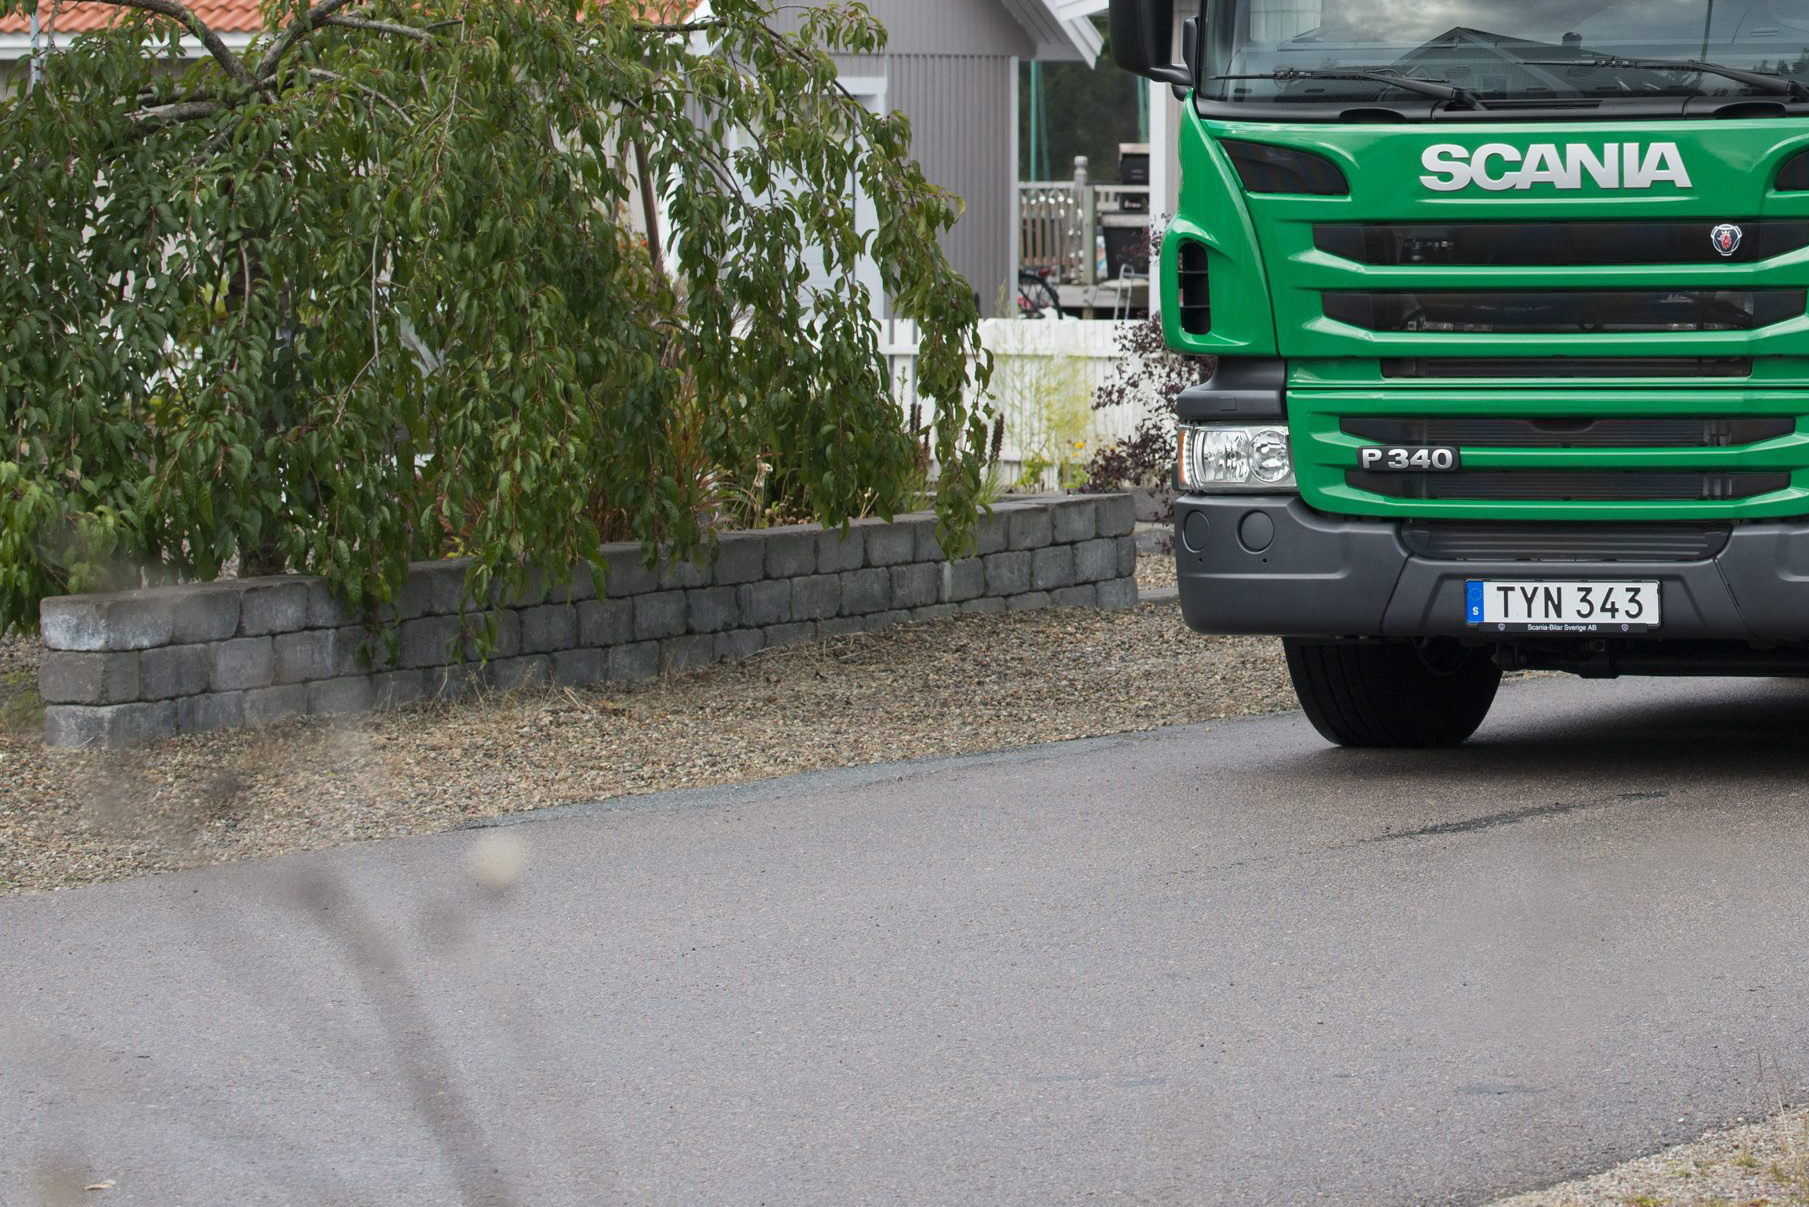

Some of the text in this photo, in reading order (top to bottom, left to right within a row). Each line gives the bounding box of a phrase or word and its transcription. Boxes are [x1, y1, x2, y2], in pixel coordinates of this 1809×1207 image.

[1419, 142, 1693, 191] SCANIA
[1362, 448, 1453, 469] P 340
[1496, 586, 1643, 619] TYN 343
[1527, 623, 1562, 631] Scania-Bilar
[1563, 624, 1586, 632] Sverige
